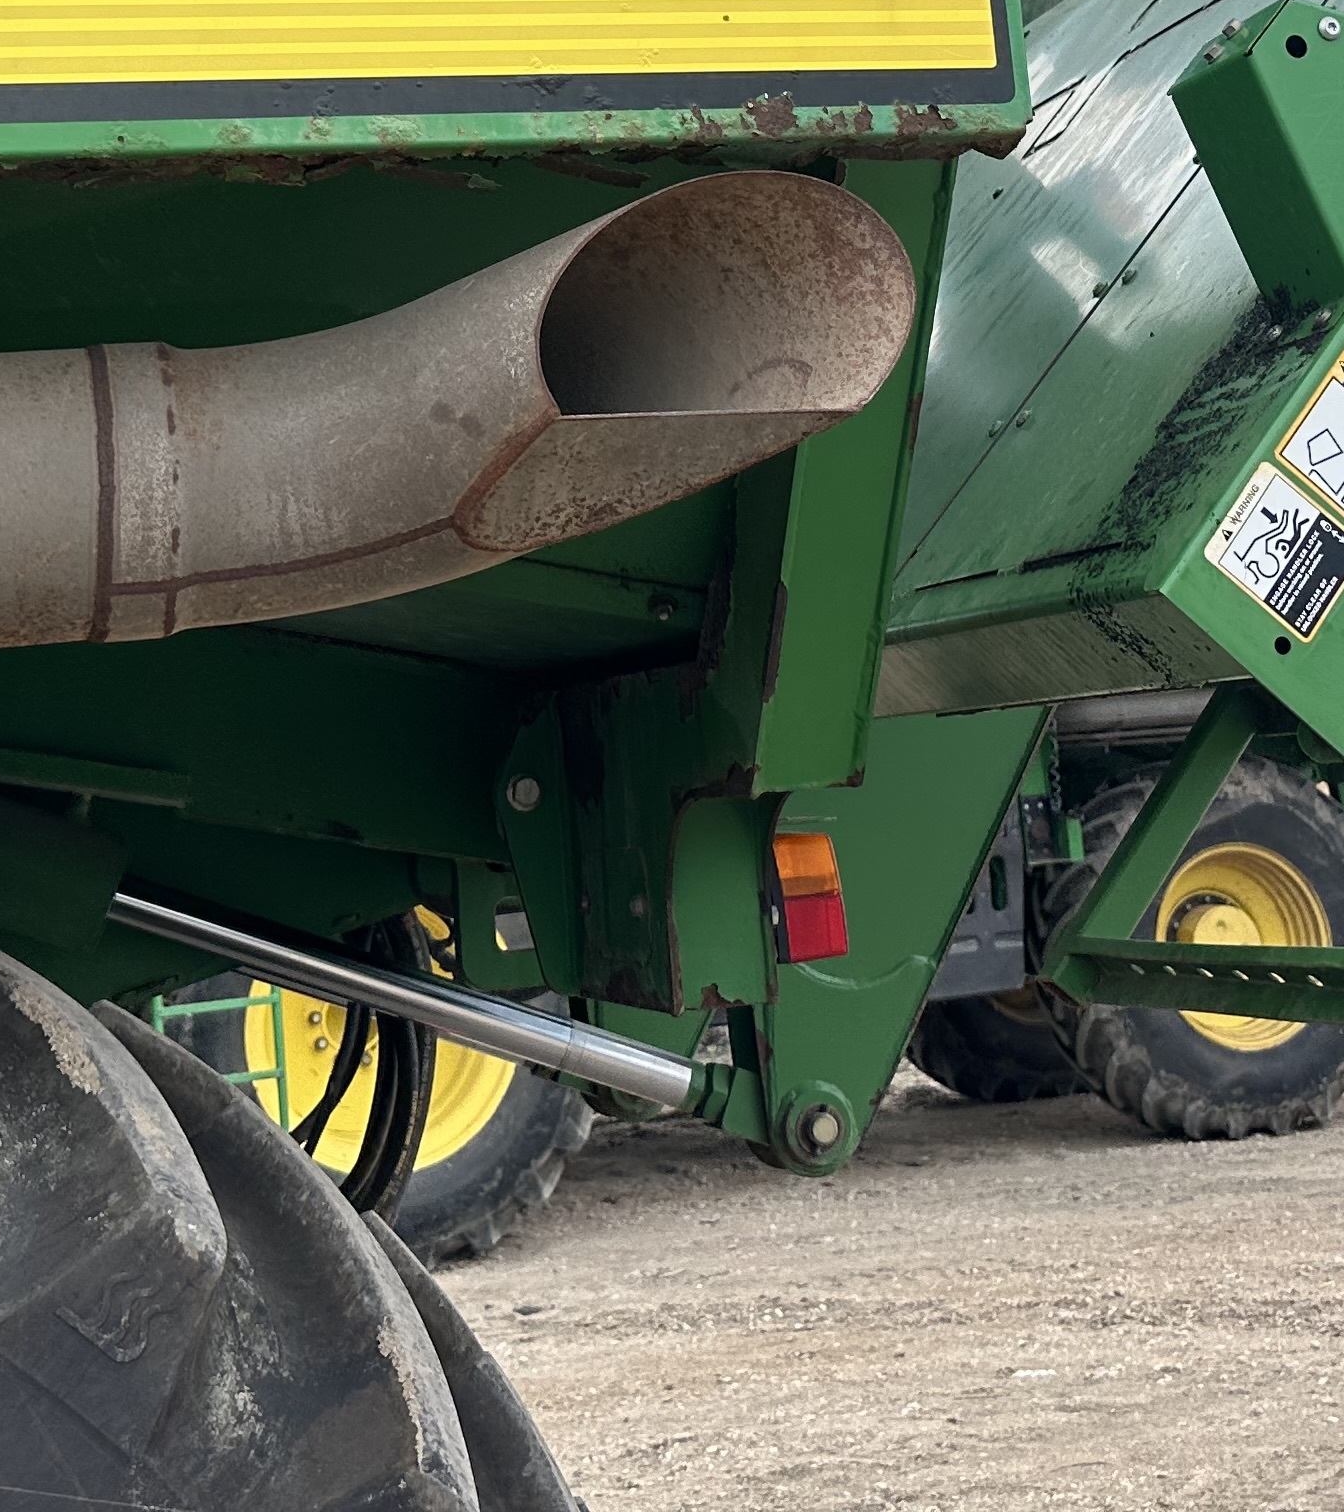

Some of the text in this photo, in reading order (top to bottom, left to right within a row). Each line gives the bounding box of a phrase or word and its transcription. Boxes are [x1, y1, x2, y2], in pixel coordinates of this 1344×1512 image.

[1229, 483, 1260, 525] WARNING
[1269, 529, 1320, 605] ENGAGE HANDLER LOCK
[1294, 609, 1307, 628] STAY
[1304, 587, 1322, 611] CLEAR
[1318, 575, 1338, 603] HANDLER
